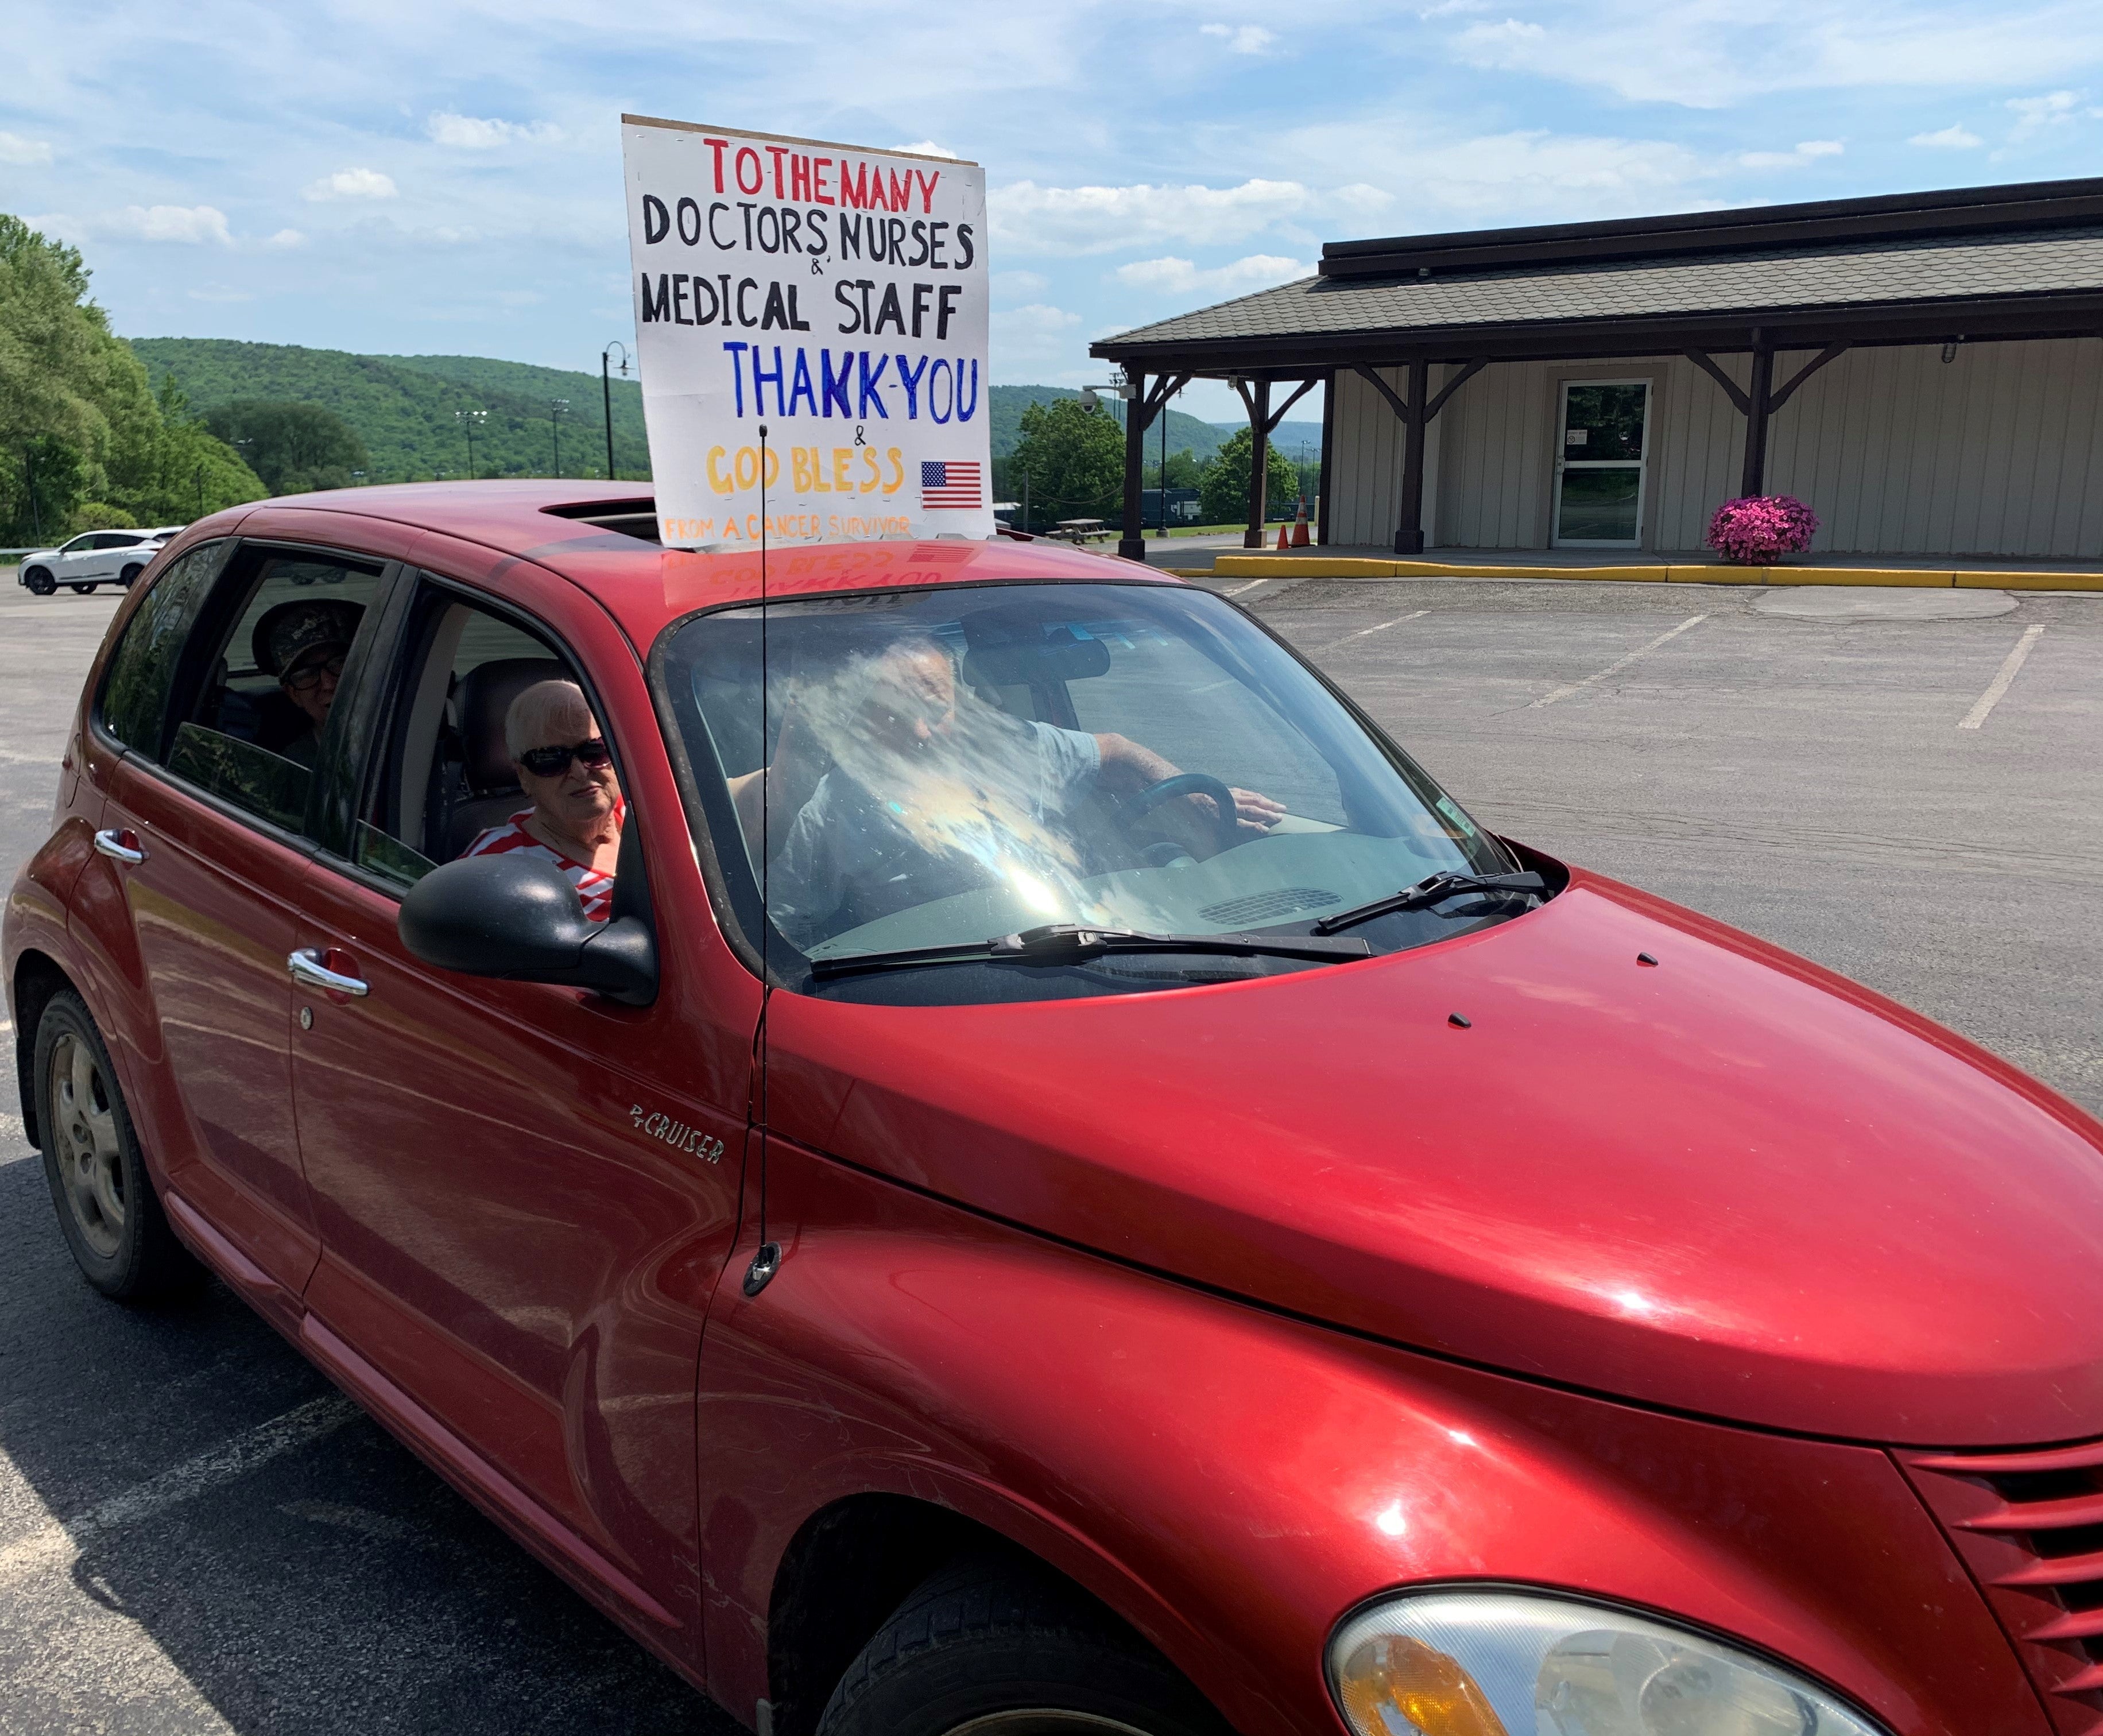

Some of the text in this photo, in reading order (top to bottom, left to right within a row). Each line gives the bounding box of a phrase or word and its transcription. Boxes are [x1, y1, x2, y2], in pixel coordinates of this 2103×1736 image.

[765, 145, 835, 206] THE
[841, 160, 940, 214] MANY
[811, 258, 824, 275] &
[839, 212, 974, 270] NURSES
[641, 272, 963, 340] MEDICAL STAFF
[854, 425, 866, 446] &
[706, 445, 905, 494] GOD BLESS
[664, 513, 913, 541] FROM A CANCER SURVIVOR
[644, 1111, 725, 1165] CRUISER
